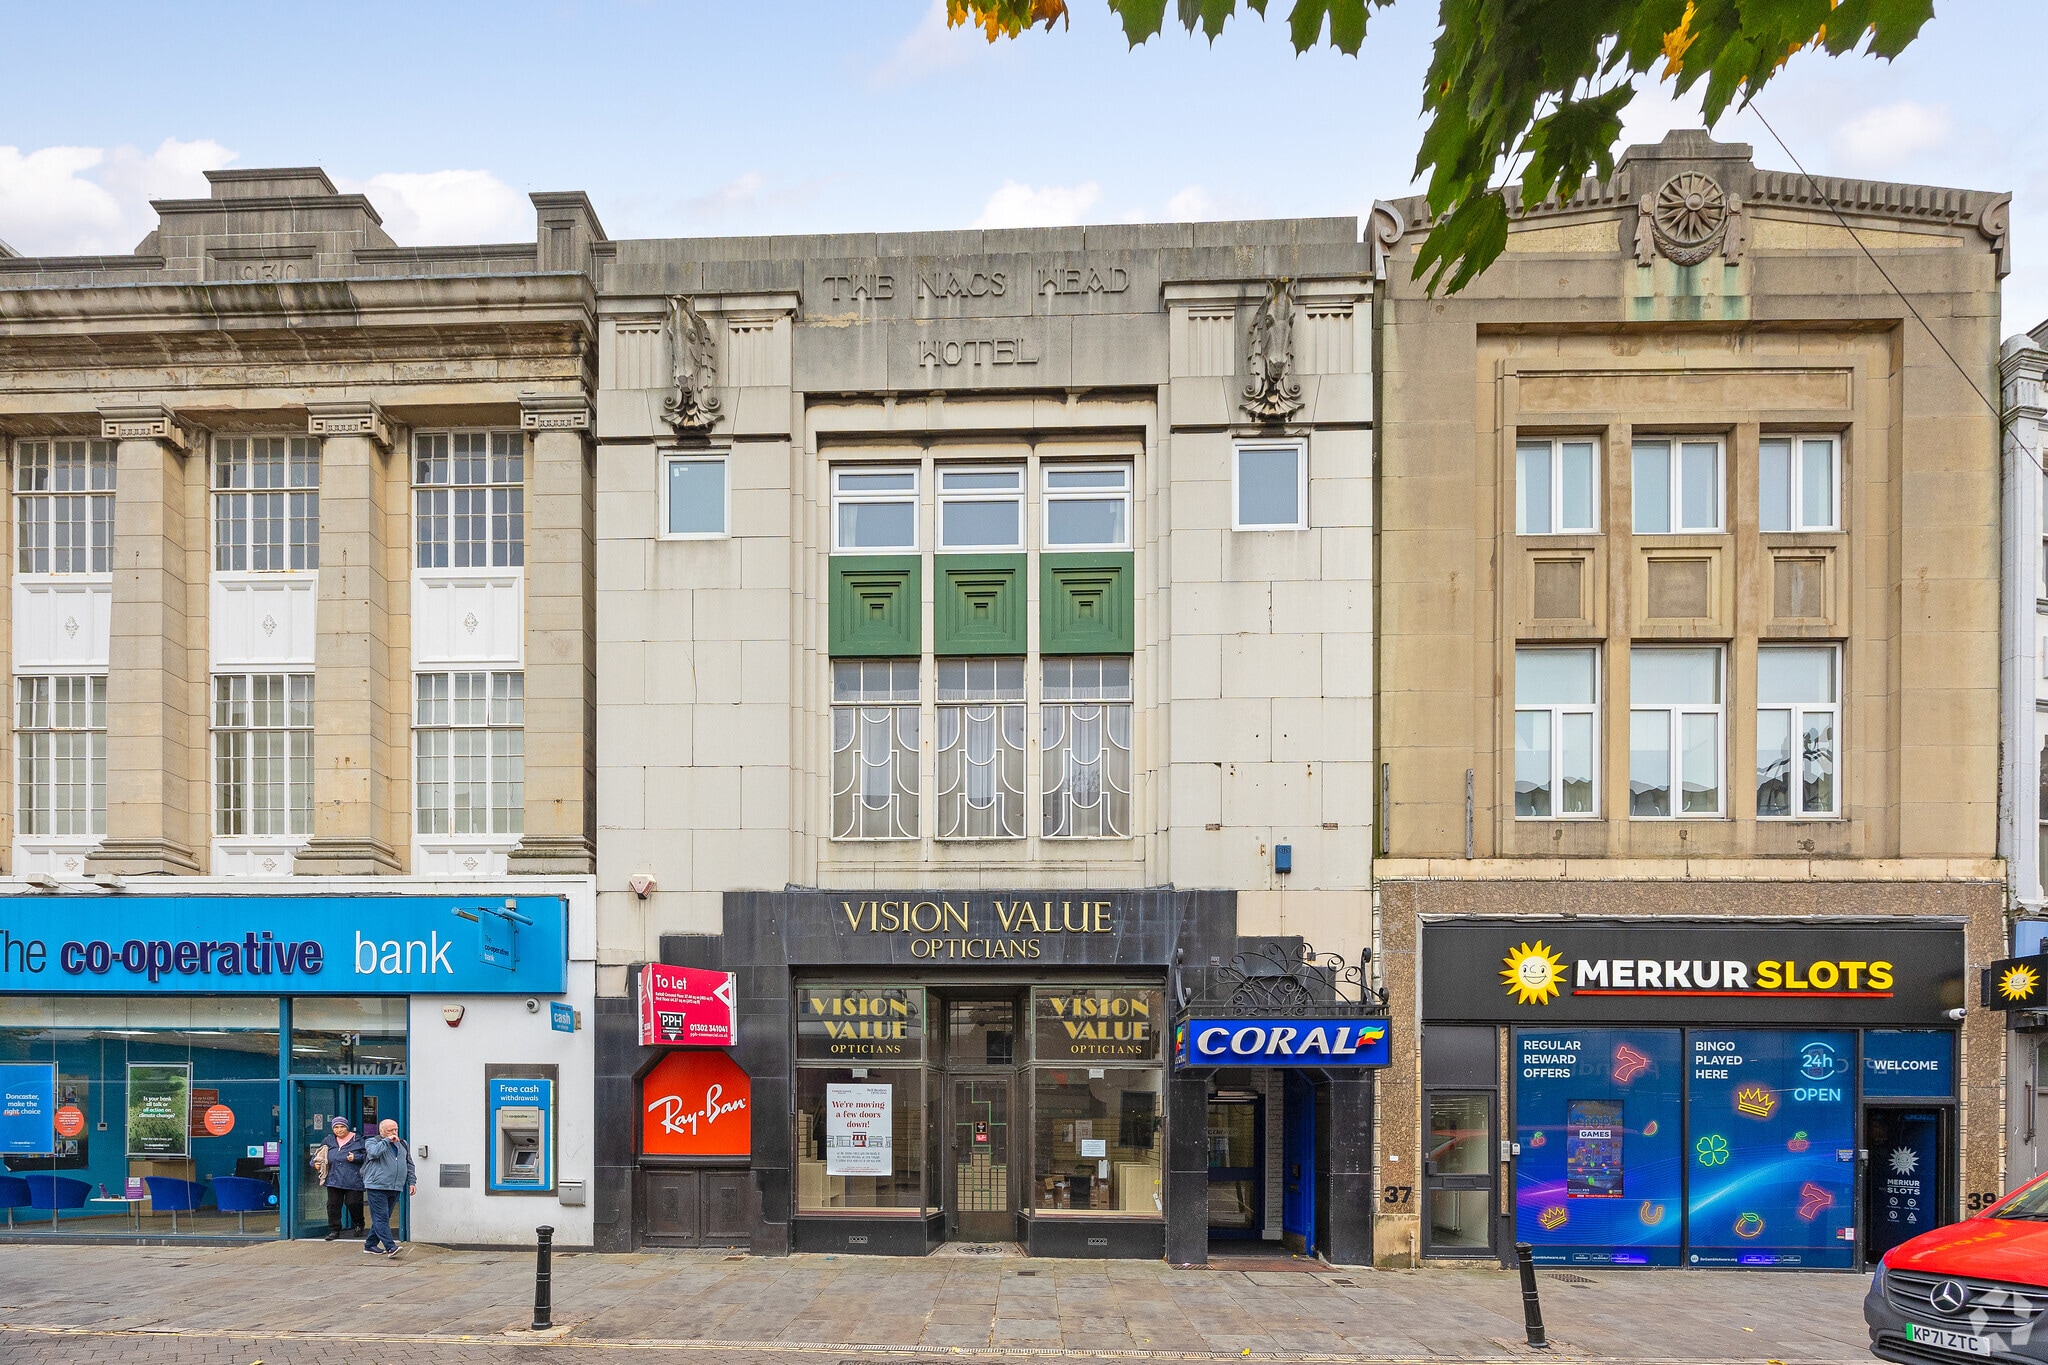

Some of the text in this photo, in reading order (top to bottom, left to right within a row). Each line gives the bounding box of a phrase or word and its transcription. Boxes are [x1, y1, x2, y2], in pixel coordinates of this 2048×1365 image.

[823, 273, 895, 300] THE
[1038, 267, 1130, 296] HEAD
[918, 337, 1039, 366] HOTEL
[840, 901, 1113, 933] VISION VALUE
[910, 938, 1041, 959] OPTICIANS
[60, 931, 323, 983] co-operative
[354, 930, 454, 974] bank
[1576, 959, 1894, 990] MERKUR SLOTS
[655, 974, 687, 990] To Let
[811, 997, 907, 1016] VISION
[1050, 997, 1149, 1017] VISION
[553, 1011, 571, 1025] cash
[662, 1015, 682, 1027] PPH
[690, 1023, 728, 1033] 01302 341041
[823, 1021, 907, 1040] VALUE
[1062, 1021, 1150, 1040] VALUE
[341, 1032, 360, 1046] 31
[1197, 1027, 1357, 1055] CORAL
[1523, 1040, 1581, 1050] REGULAR
[1695, 1041, 1735, 1051] BINGO
[830, 1044, 901, 1053] OPTICIANS
[1070, 1044, 1142, 1054] OPTICIANS
[1523, 1054, 1576, 1064] REWARD
[1695, 1055, 1743, 1065] PLAYED
[1802, 1053, 1833, 1068] 24h
[1873, 1060, 1938, 1070] WELCOME
[1523, 1068, 1571, 1078] OFFERS
[1695, 1069, 1729, 1079] HERE
[500, 1084, 539, 1093] Free cash
[1794, 1087, 1841, 1101] OPEN
[4, 1108, 20, 1116] right
[855, 1101, 885, 1110] moving
[843, 1110, 857, 1118] few
[859, 1110, 881, 1118] doors
[846, 1120, 870, 1128] down!
[1384, 1186, 1412, 1203] 37
[1887, 1187, 1920, 1195] SLOTS
[1967, 1192, 1996, 1210] 39
[1913, 1326, 1978, 1351] KP71 ZTC
